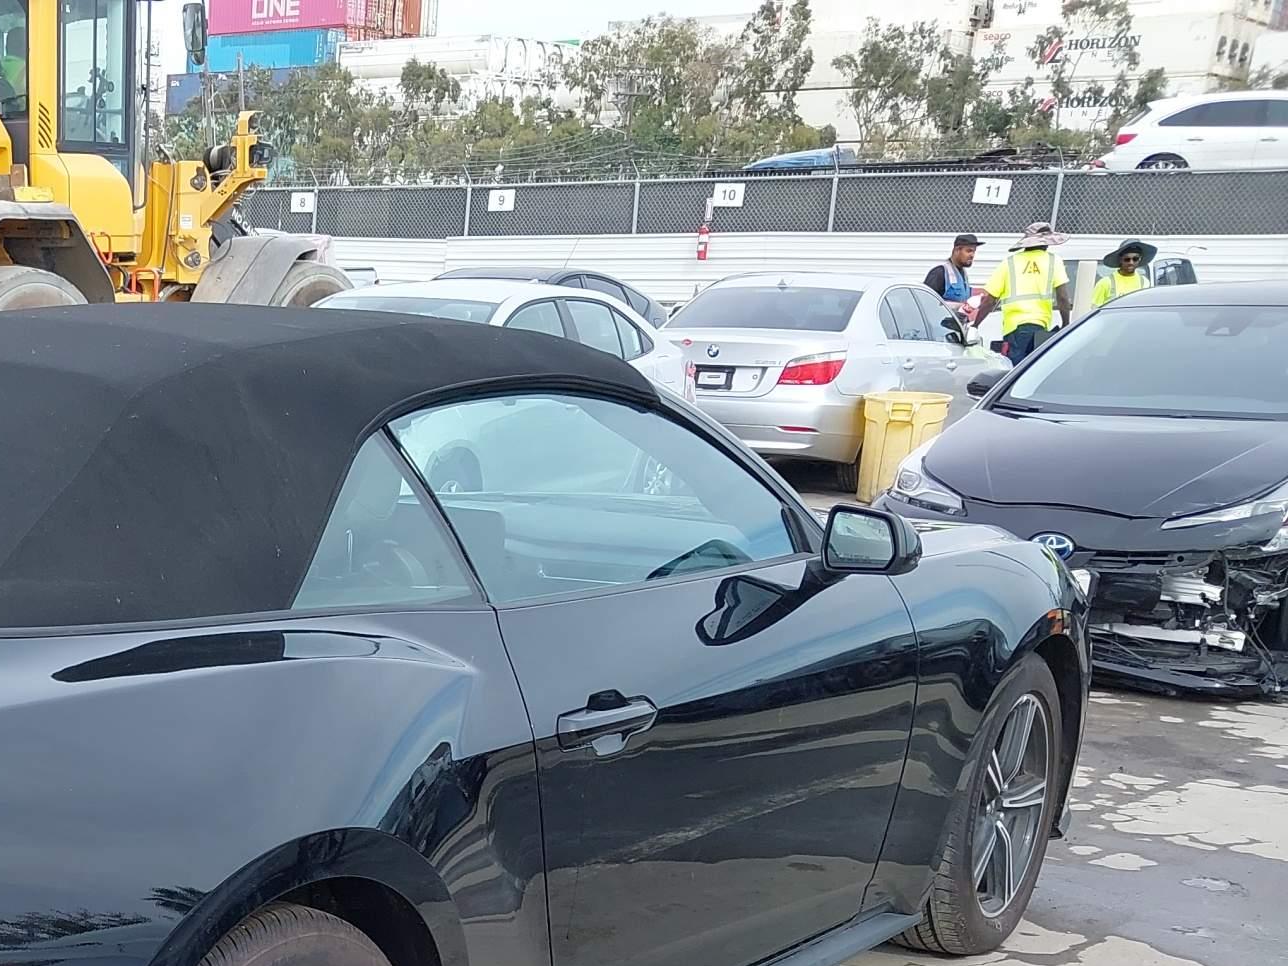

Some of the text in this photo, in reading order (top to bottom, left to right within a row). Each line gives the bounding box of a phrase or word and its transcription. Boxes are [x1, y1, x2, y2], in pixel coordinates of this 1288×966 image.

[251, 0, 300, 19] ONE
[983, 32, 1011, 41] seaco
[1068, 35, 1141, 51] HORIZON
[722, 189, 737, 201] 10
[985, 184, 1001, 198] 11
[299, 197, 306, 208] 8
[498, 194, 506, 206] 9
